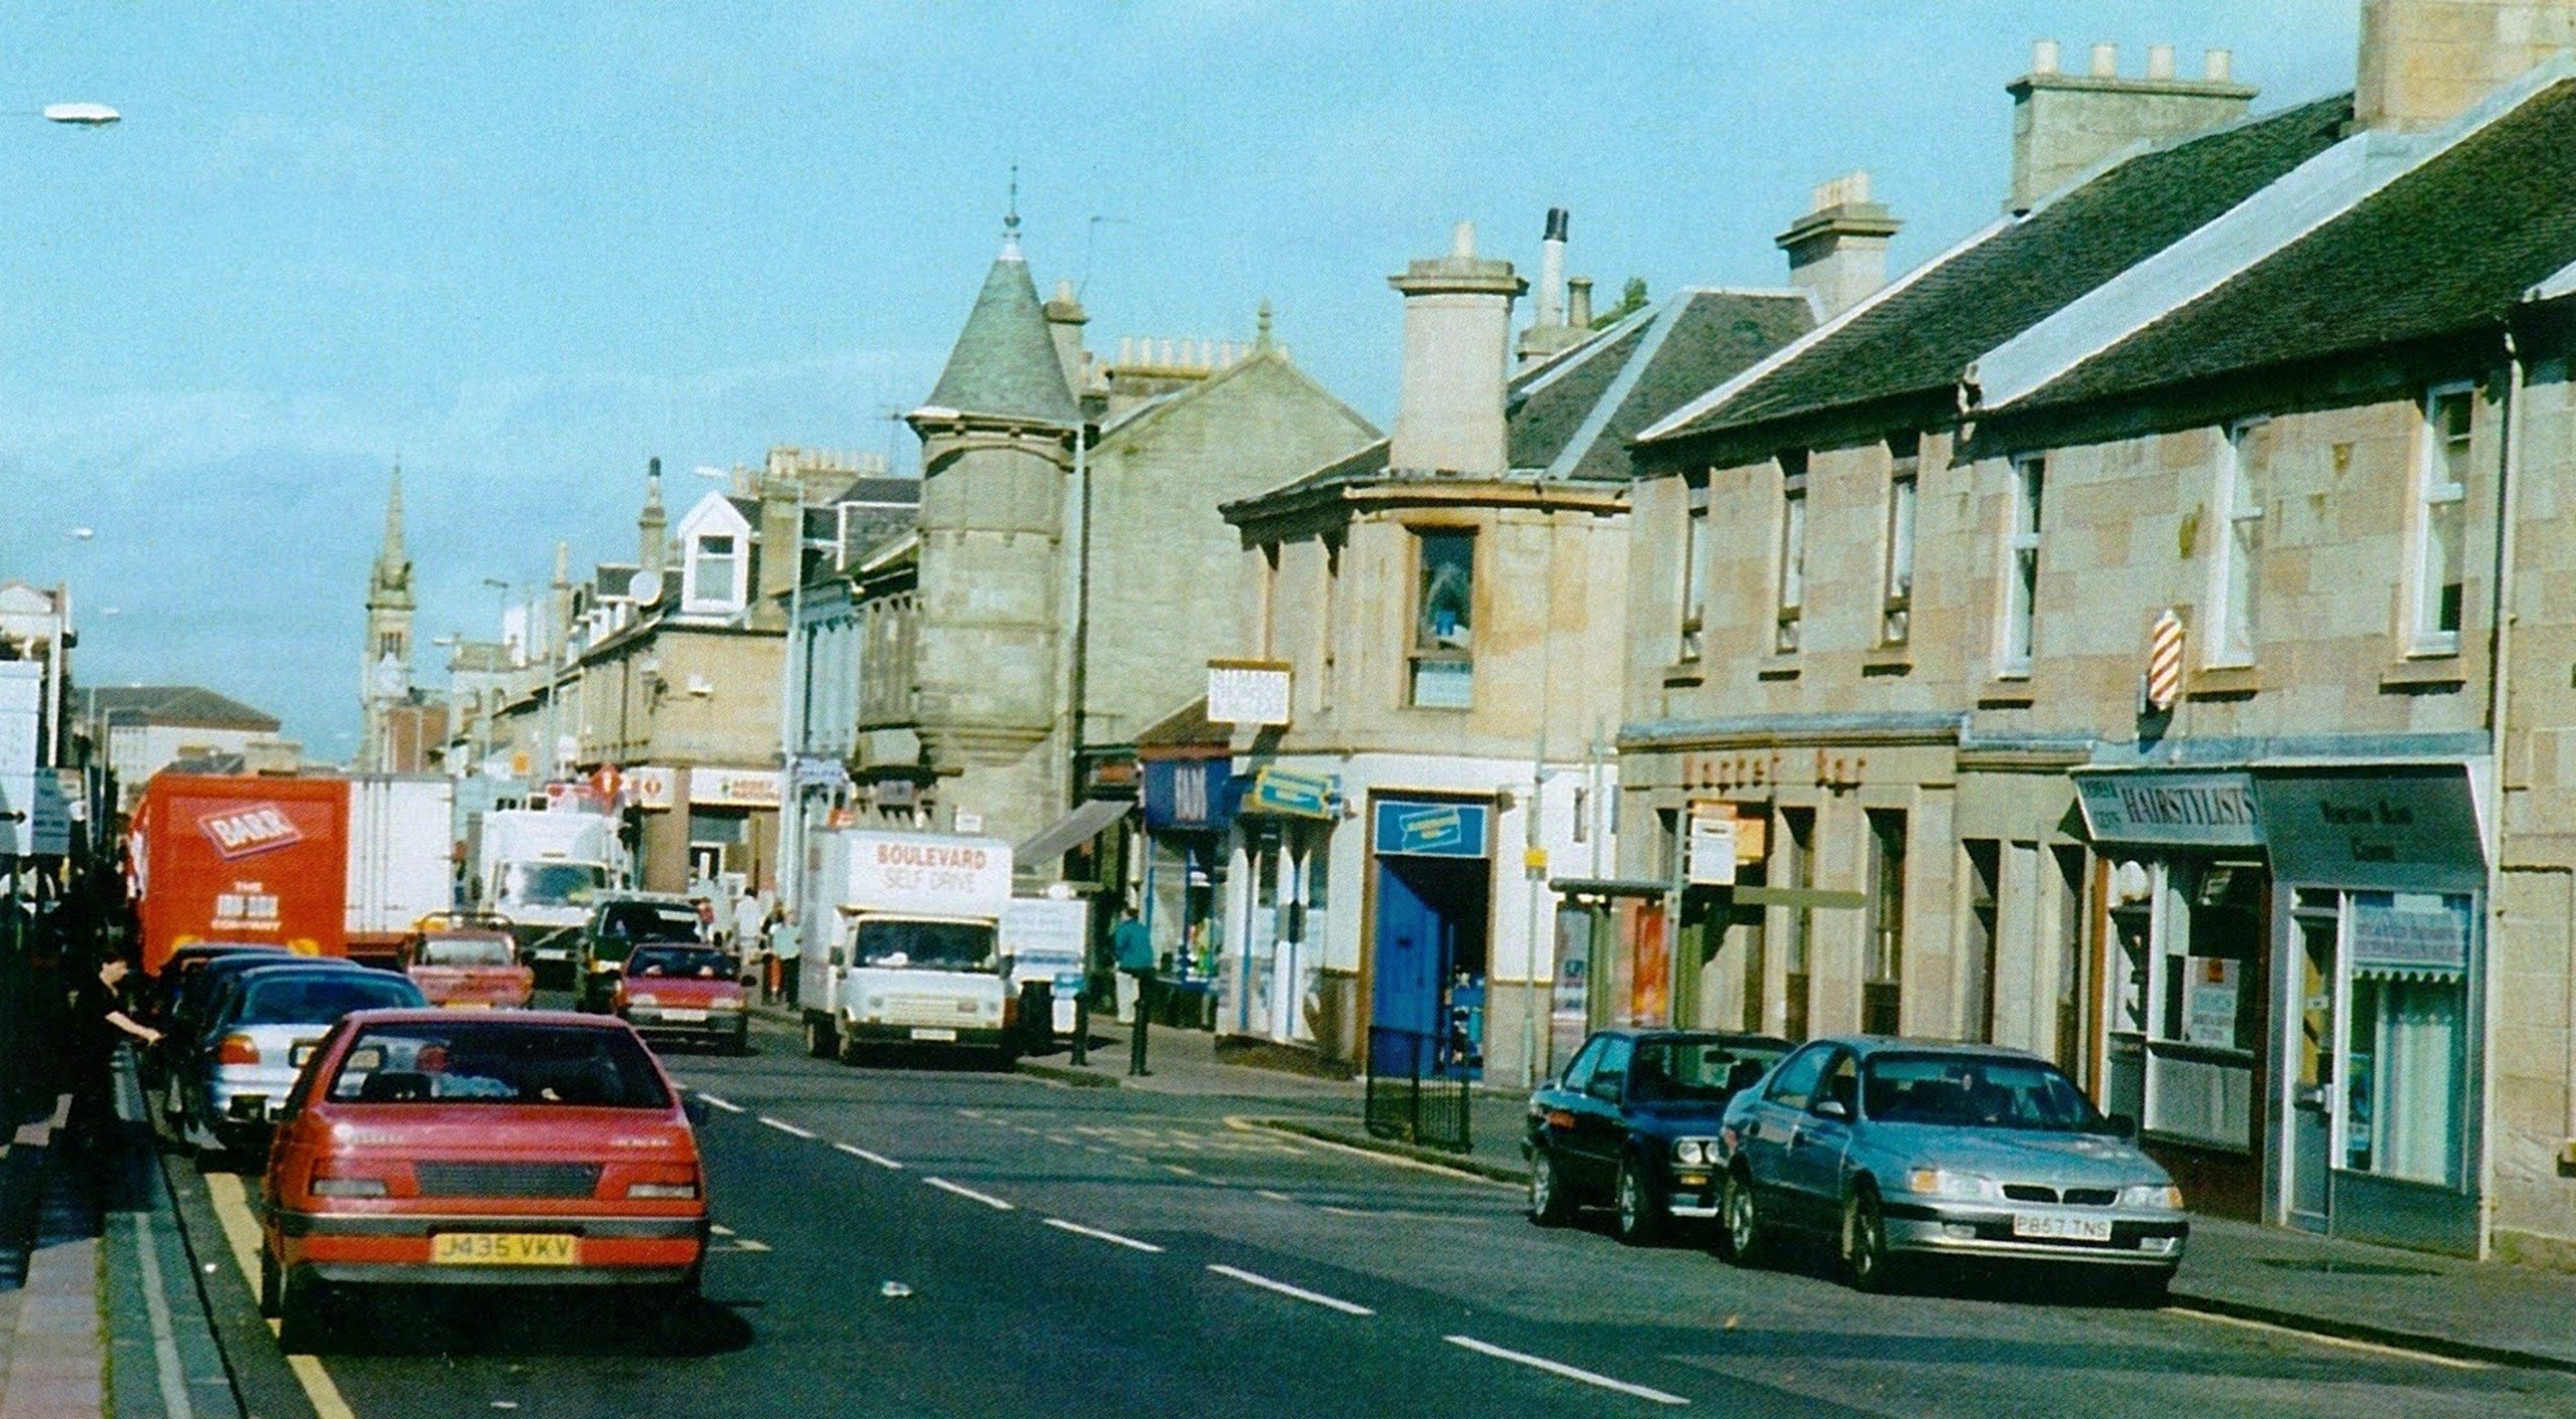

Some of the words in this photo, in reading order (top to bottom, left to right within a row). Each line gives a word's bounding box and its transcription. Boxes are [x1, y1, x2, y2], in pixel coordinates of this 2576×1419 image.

[2123, 786, 2259, 826] HAIRSTYLISTS
[211, 810, 294, 847] BARR
[877, 844, 988, 870] BOULEVARD
[884, 869, 924, 890] SELF
[930, 871, 976, 894] DRIVE
[2017, 1216, 2065, 1234] P857
[2072, 1219, 2107, 1238] TNS
[442, 1236, 509, 1258] J435
[519, 1236, 571, 1259] VKV
